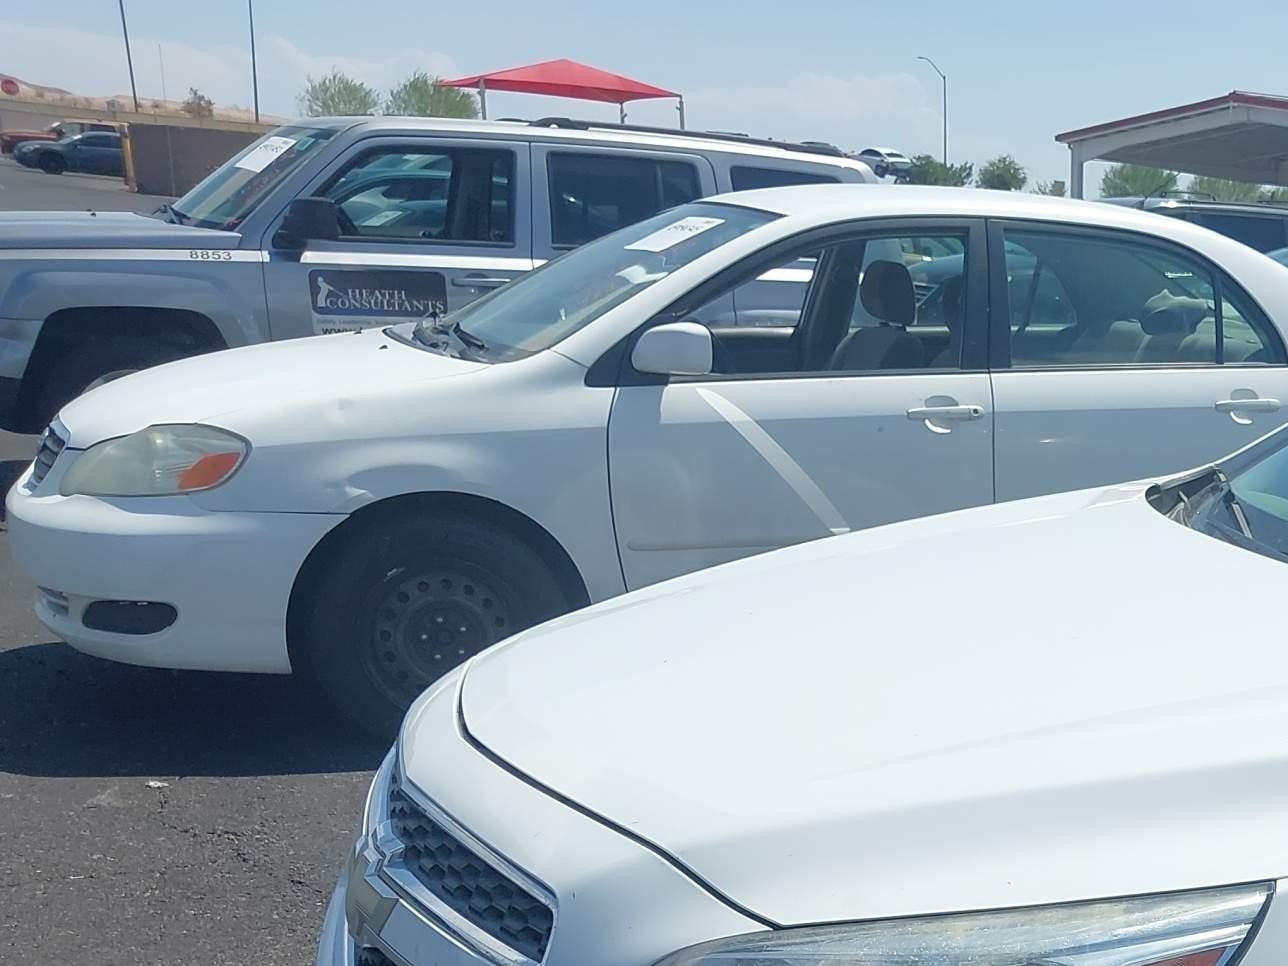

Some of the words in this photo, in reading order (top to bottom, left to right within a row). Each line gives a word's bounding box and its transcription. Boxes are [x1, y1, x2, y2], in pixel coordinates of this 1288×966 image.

[189, 250, 232, 260] 8853
[348, 289, 406, 300] HEATH
[326, 297, 444, 312] CONSULTANTS
